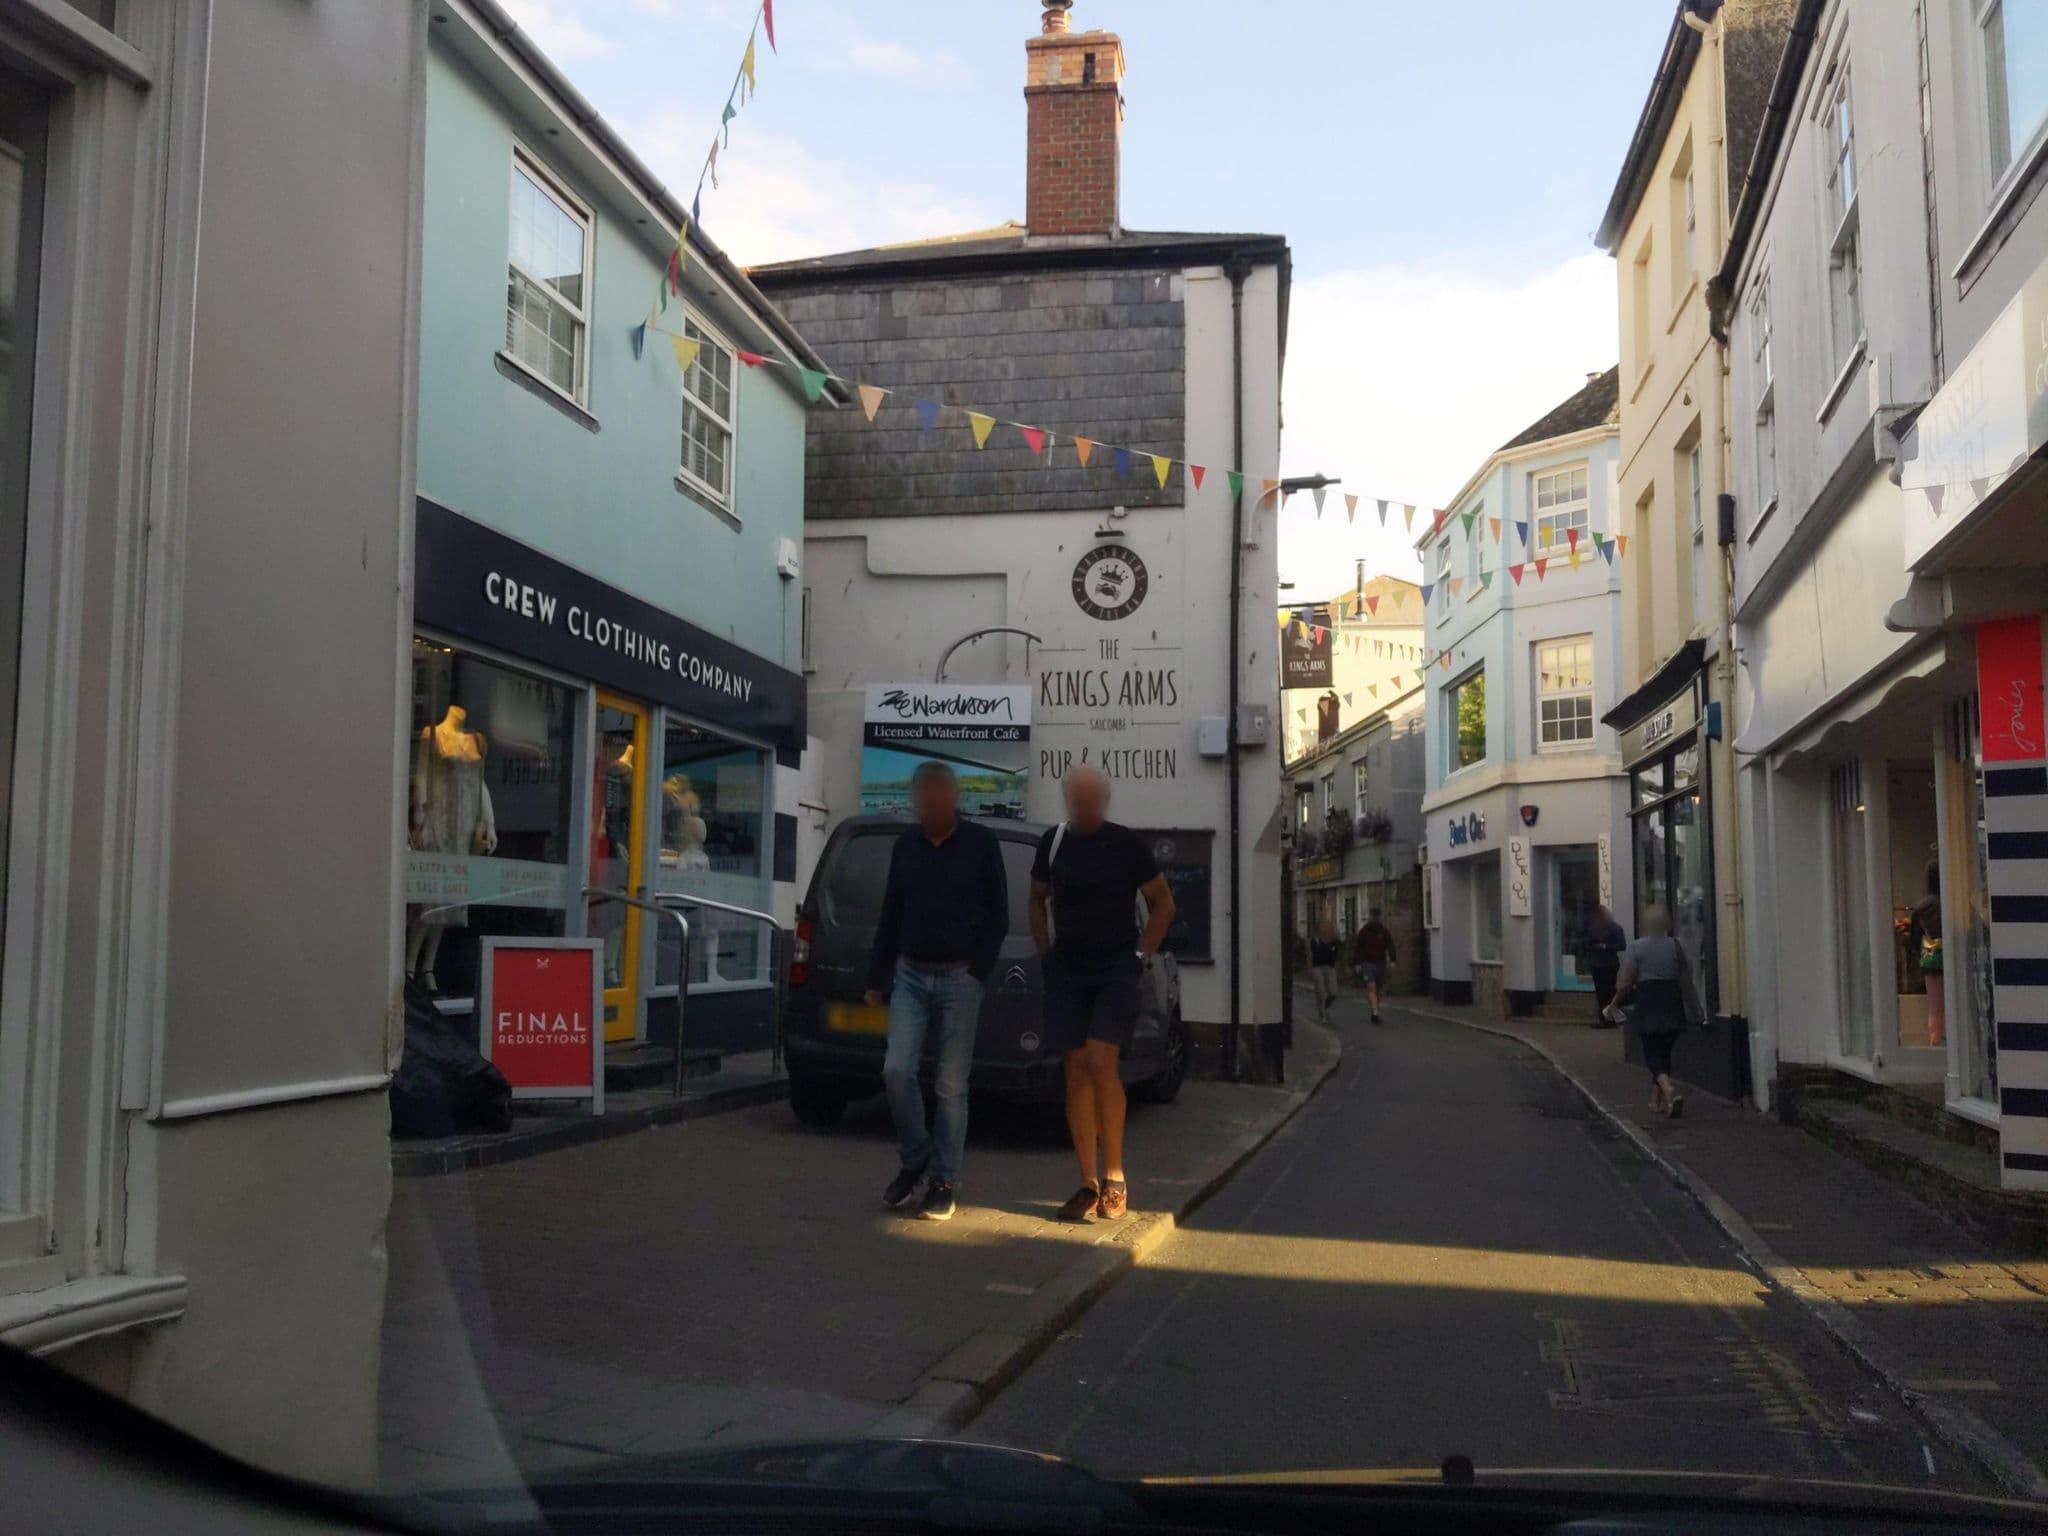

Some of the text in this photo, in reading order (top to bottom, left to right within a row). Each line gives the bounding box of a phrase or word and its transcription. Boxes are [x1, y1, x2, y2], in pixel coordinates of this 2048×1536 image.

[485, 571, 753, 703] CREW CLOTHING COMPANY
[1099, 638, 1120, 660] THE
[1040, 669, 1178, 708] KINGS ARMS
[911, 694, 1013, 721] Wardroom
[874, 725, 1020, 740] Licensed Waterfront Café
[1102, 748, 1177, 780] KITCHEN
[498, 1012, 588, 1033] FINAL
[498, 1034, 588, 1046] REDUCTIONS
